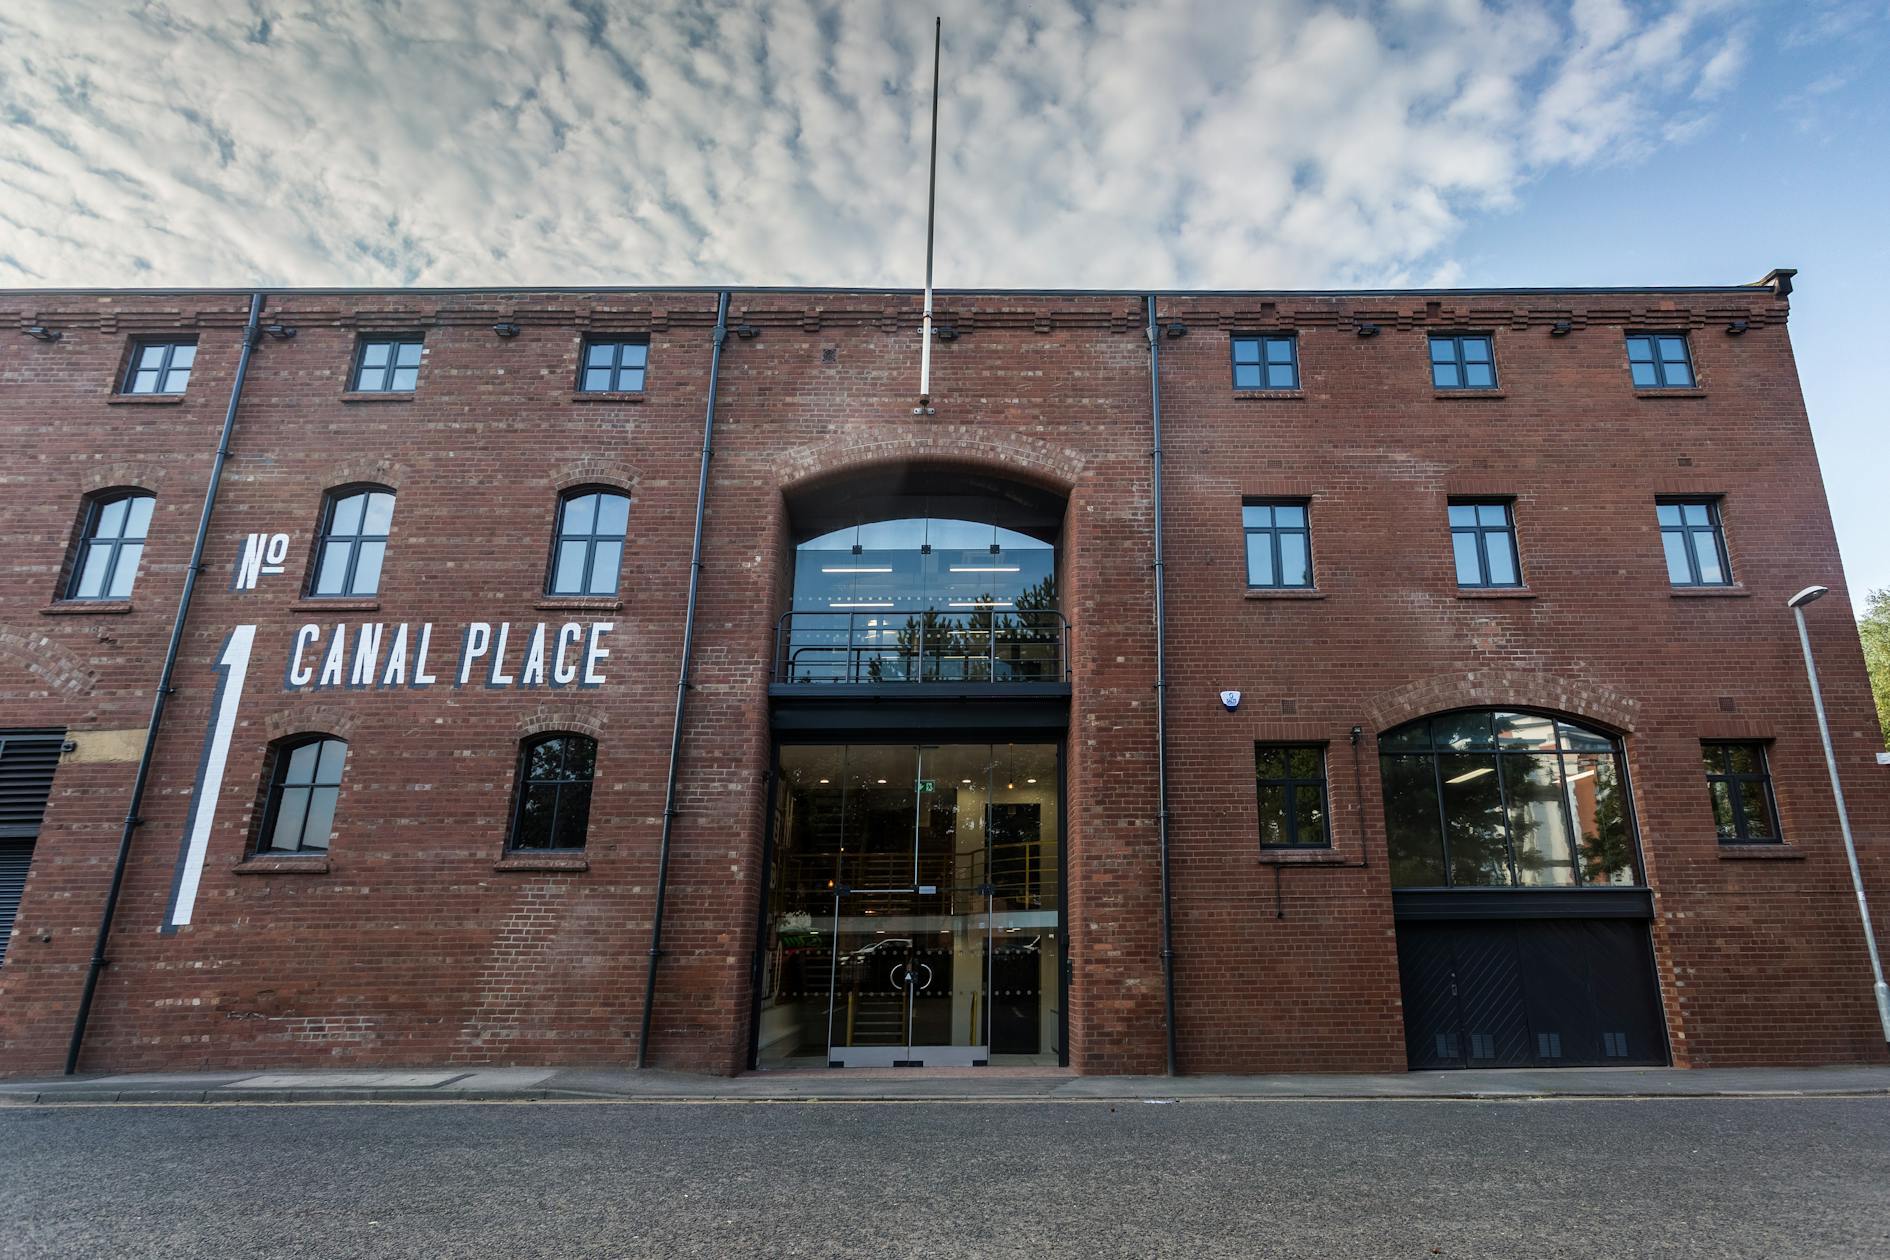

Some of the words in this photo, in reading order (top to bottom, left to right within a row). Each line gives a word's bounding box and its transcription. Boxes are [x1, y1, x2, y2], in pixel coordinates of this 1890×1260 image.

[290, 622, 437, 686] CANAL
[460, 621, 615, 684] PLACE
[171, 624, 257, 926] 1
